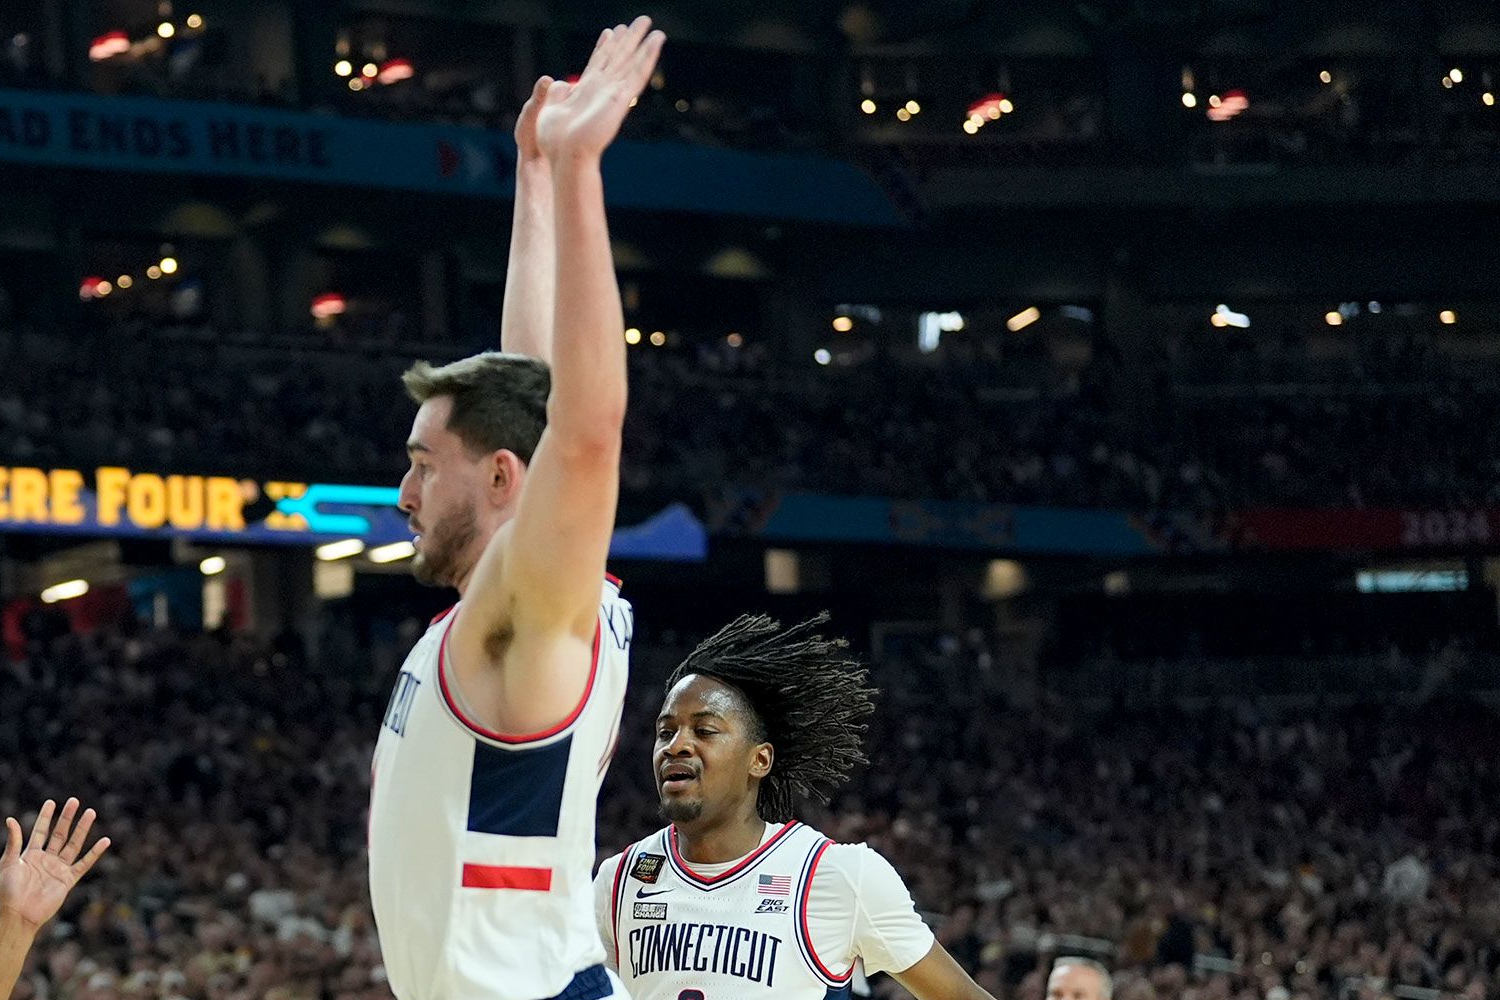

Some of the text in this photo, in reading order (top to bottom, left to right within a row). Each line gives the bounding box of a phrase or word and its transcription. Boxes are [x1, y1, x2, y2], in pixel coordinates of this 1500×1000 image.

[67, 108, 194, 159] ENDS
[207, 118, 332, 167] HERE
[97, 467, 246, 531] FOUR
[629, 923, 782, 987] CONNECTICUT
